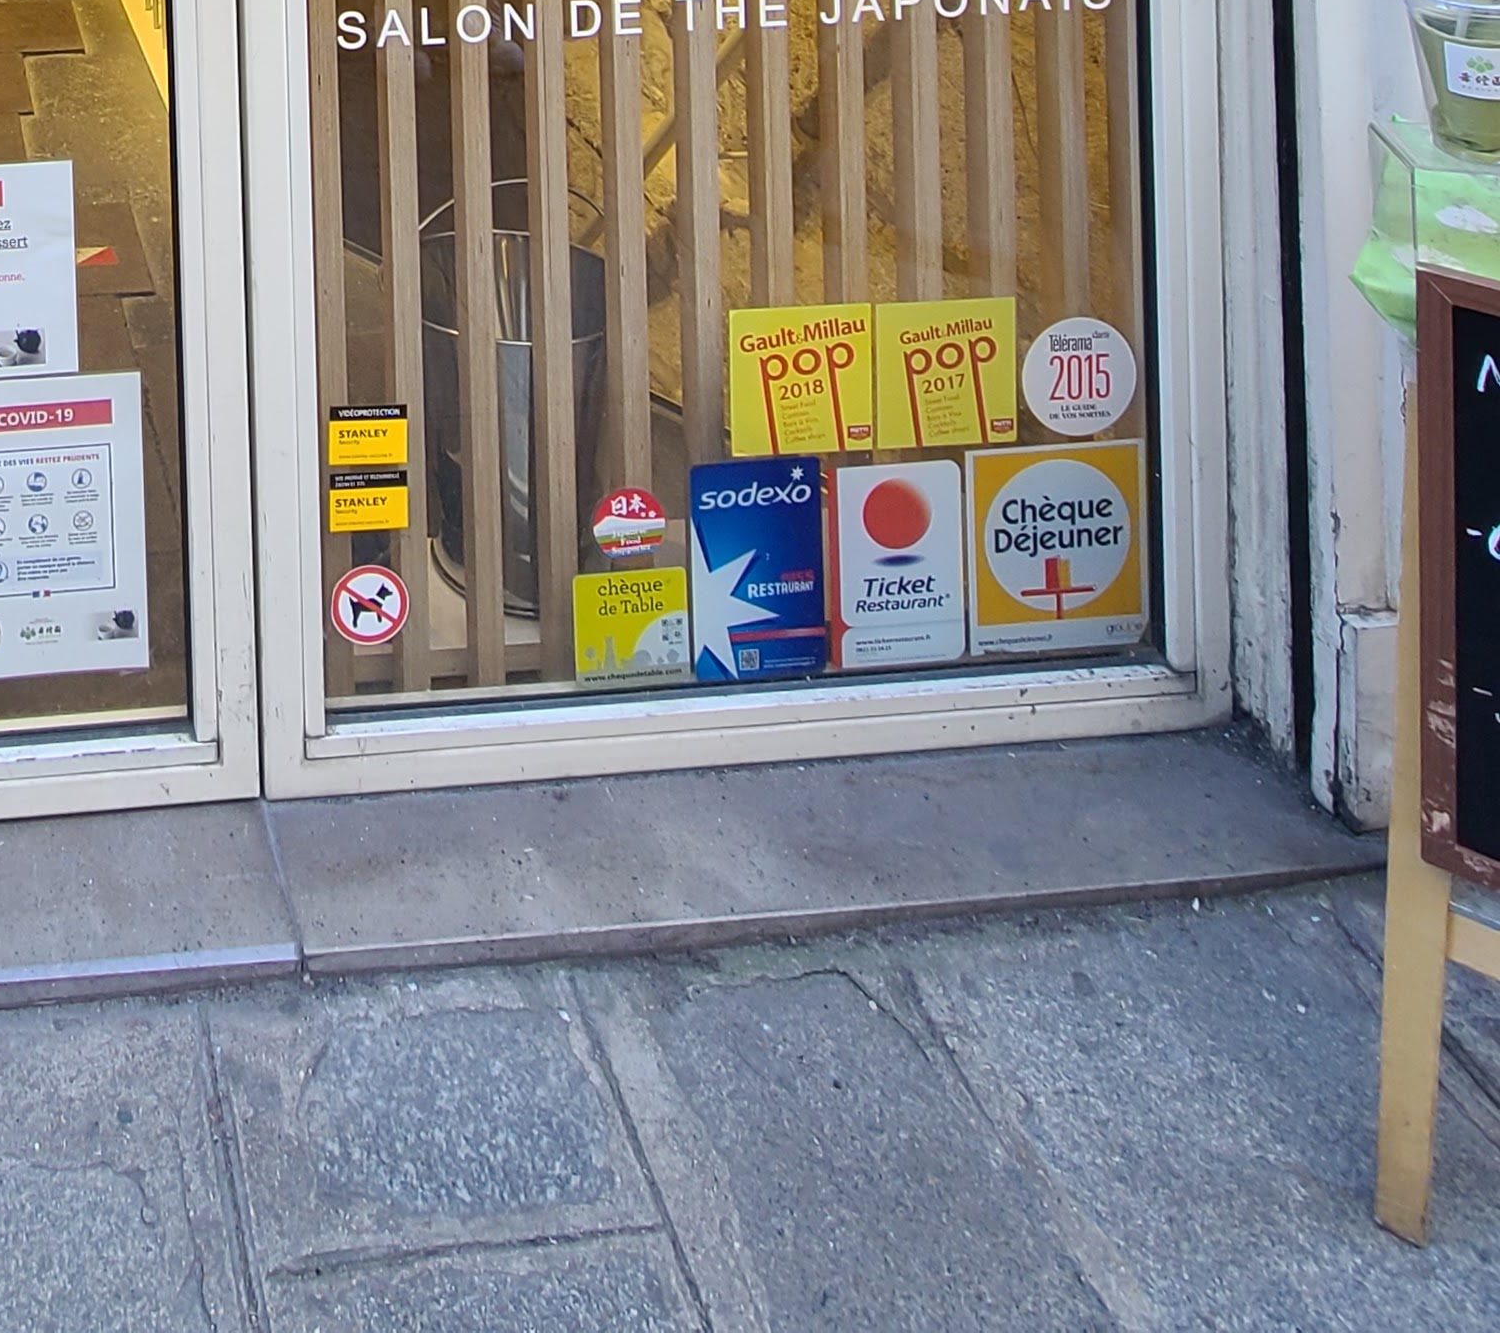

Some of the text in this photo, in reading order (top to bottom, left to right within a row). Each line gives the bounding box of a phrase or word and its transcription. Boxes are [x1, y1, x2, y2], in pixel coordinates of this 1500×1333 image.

[336, 2, 536, 50] SALON
[740, 317, 866, 353] Gault&Millau
[1048, 334, 1093, 352] Télérama
[922, 373, 966, 395] 2017
[1049, 353, 1111, 401] 2015
[779, 378, 825, 401] 2018
[1072, 403, 1097, 411] GUIDE
[338, 429, 388, 439] STANLEY
[3, 459, 17, 467] DES
[18, 458, 34, 466] VIES
[35, 456, 61, 464] RESTEZ
[62, 453, 100, 462] PRUDENTS
[335, 497, 387, 508] STANLEY
[610, 493, 646, 516] 日本
[698, 482, 812, 511] sodexo
[1001, 496, 1114, 533] Chèque
[620, 536, 642, 546] Food
[994, 520, 1124, 558] Déjeuner
[597, 578, 664, 597] chèque
[747, 581, 814, 599] RESTAURANT
[862, 575, 936, 598] Ticket
[598, 598, 664, 616] de Table
